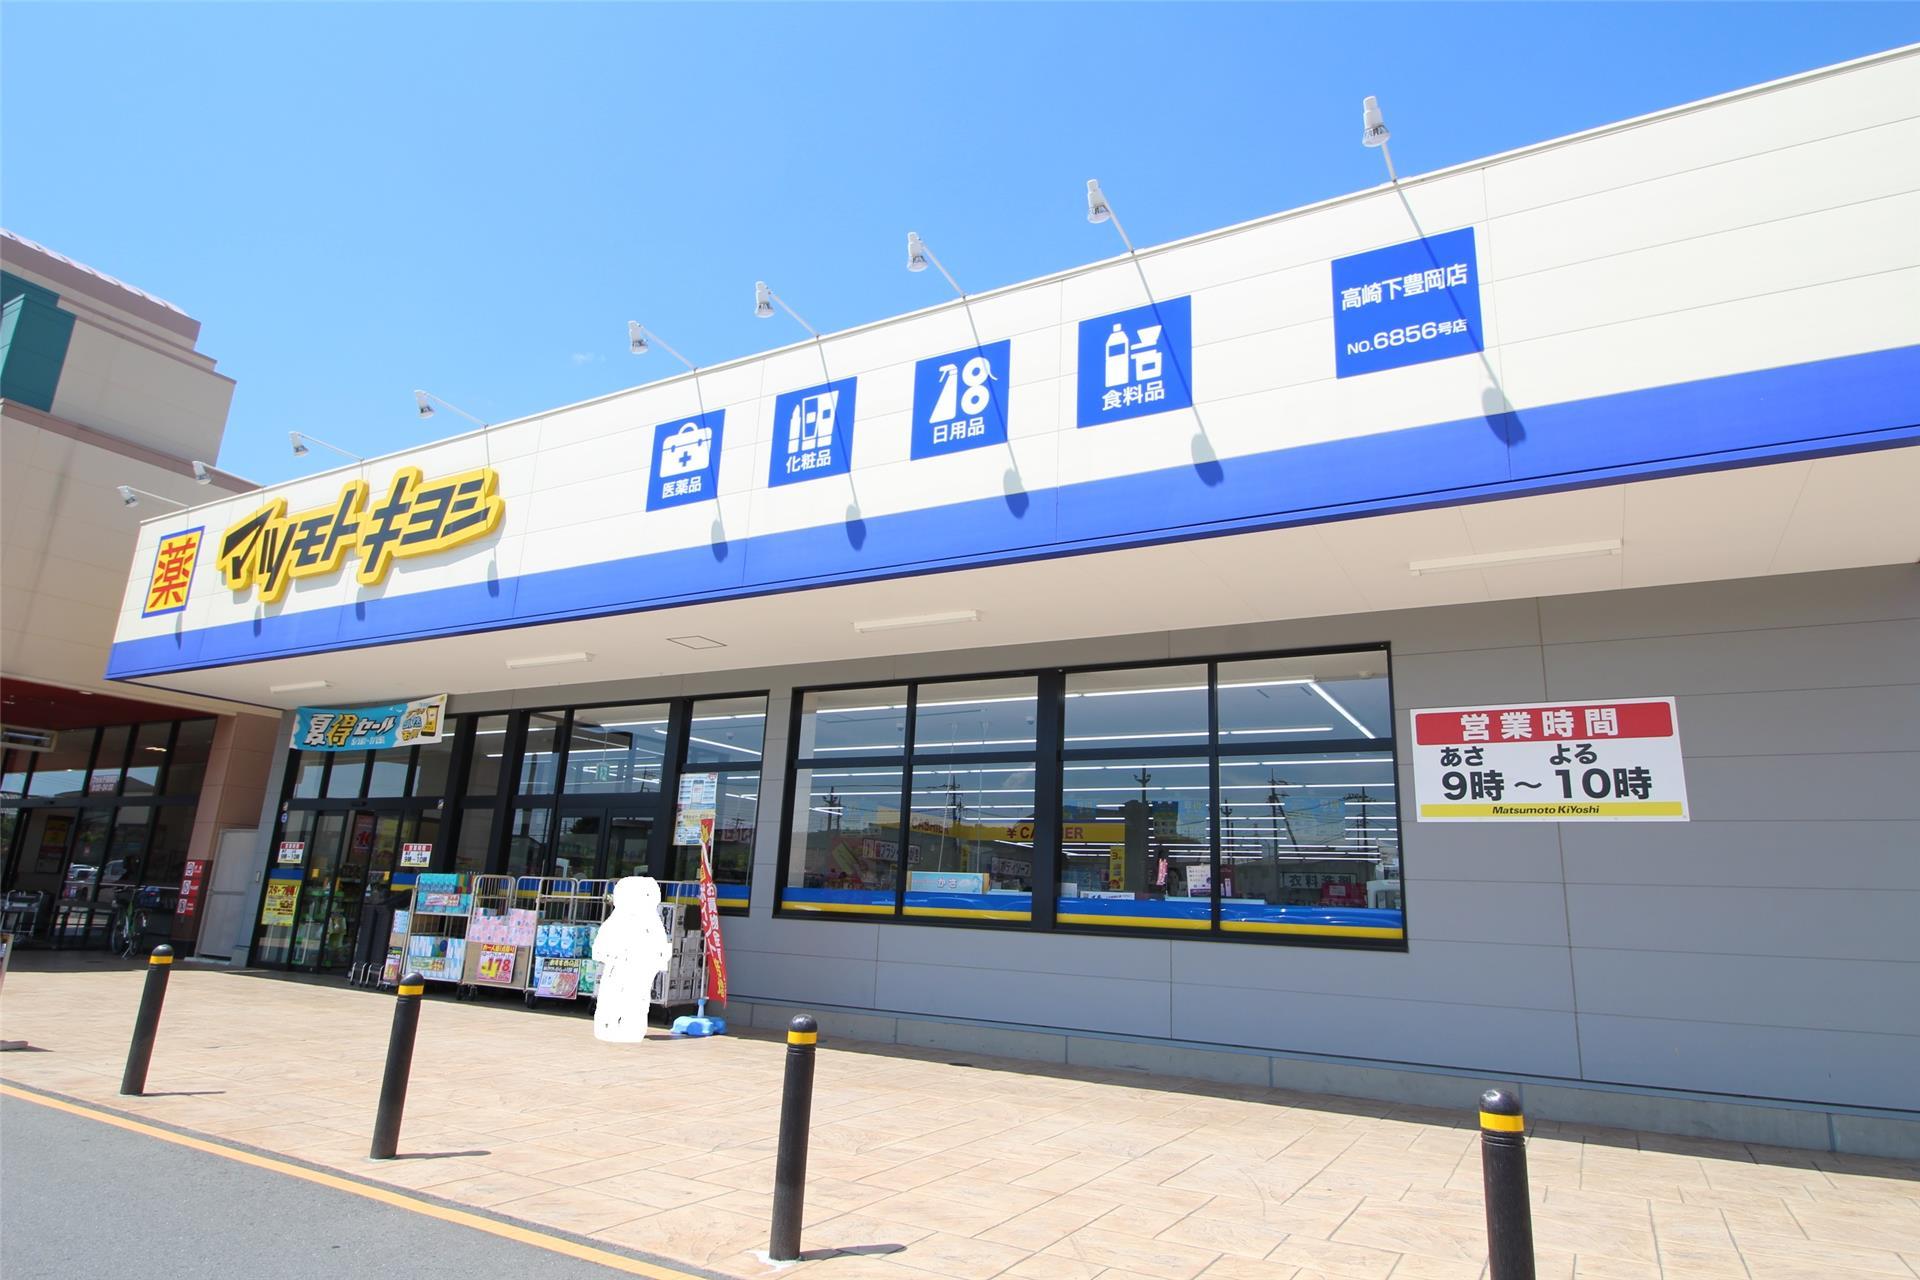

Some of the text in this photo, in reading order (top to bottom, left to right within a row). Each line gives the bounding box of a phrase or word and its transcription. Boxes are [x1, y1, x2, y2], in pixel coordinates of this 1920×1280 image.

[1341, 263, 1468, 310] 高崎下豊岡店
[1102, 380, 1165, 411] 食料品
[933, 417, 985, 444] 日用品
[786, 449, 832, 473] 化粧品
[662, 476, 702, 499] 医薬品
[219, 471, 493, 595] マツモトキヨシ
[149, 537, 192, 608] 薬
[1459, 708, 1619, 741] 営業時間
[1440, 743, 1598, 767] あさ よる
[1492, 804, 1599, 815] Matsumoto KiYoshi
